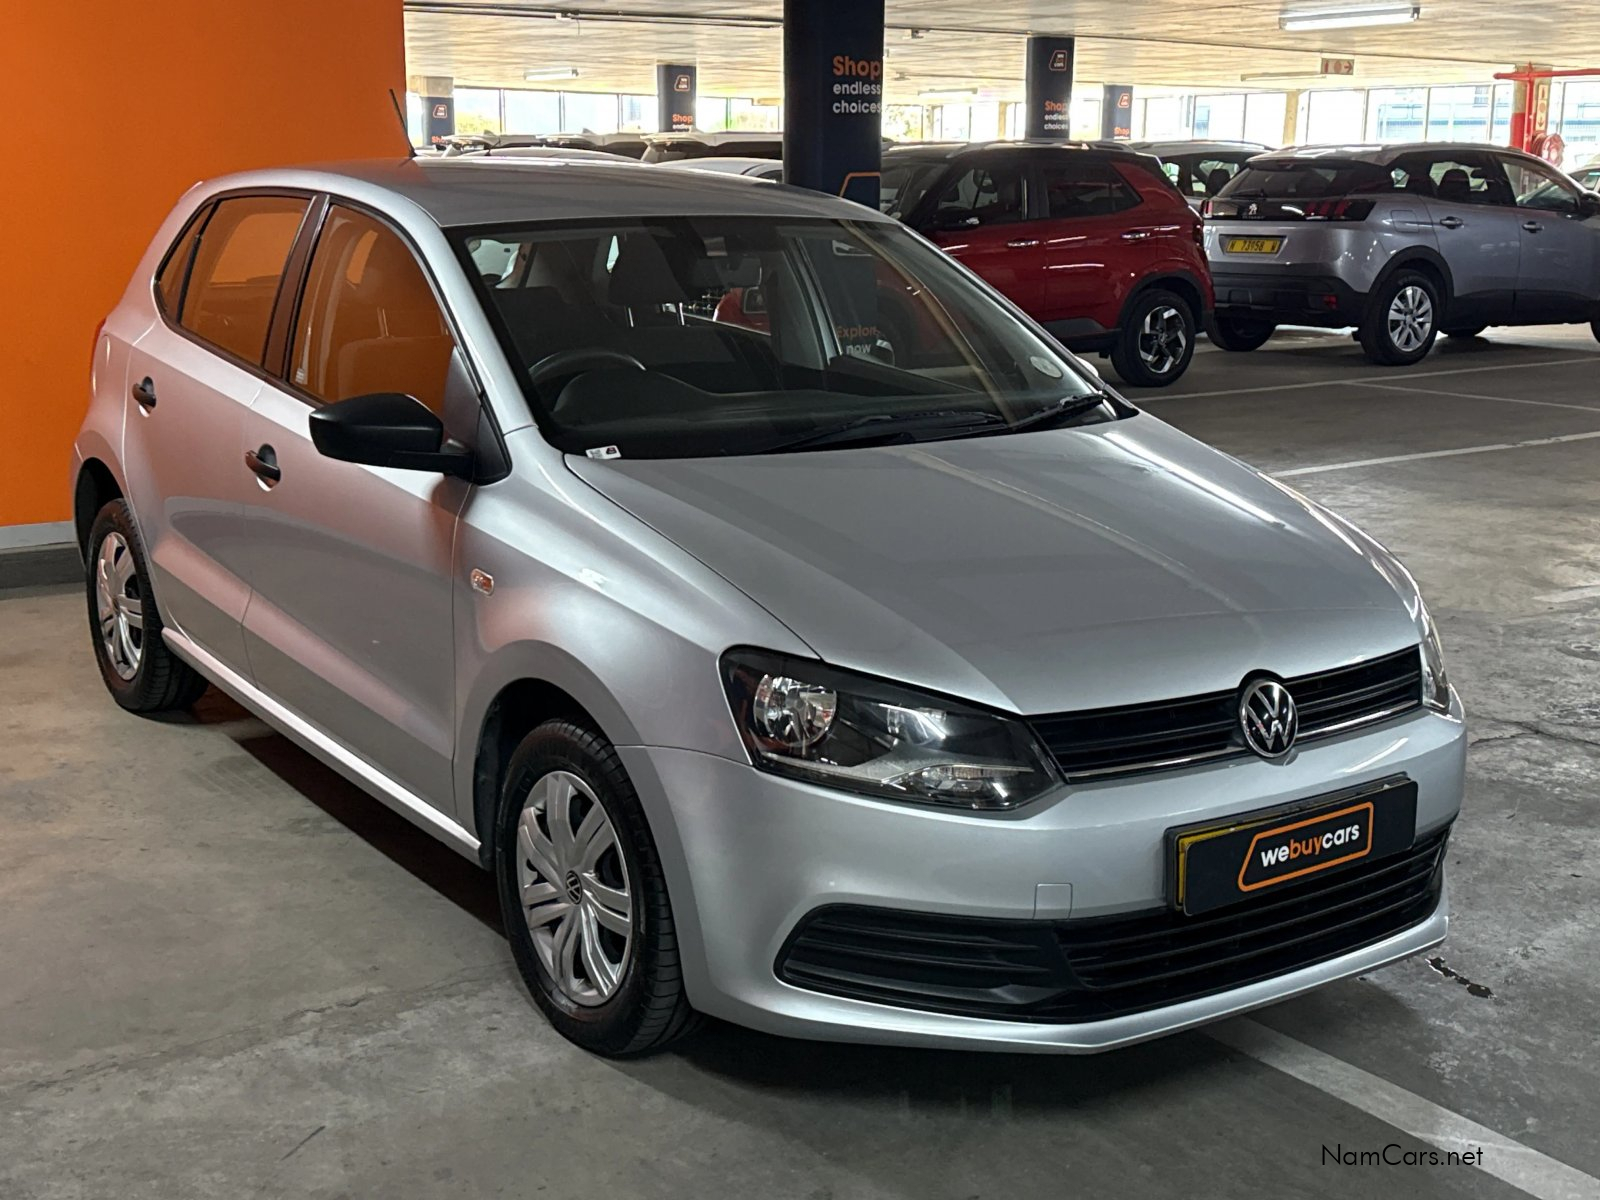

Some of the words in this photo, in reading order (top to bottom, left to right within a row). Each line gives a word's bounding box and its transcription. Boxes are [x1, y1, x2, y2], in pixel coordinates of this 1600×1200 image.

[832, 55, 881, 80] Shop
[832, 81, 881, 95] endless
[832, 99, 882, 114] choices
[1044, 100, 1068, 113] Shop
[672, 113, 693, 124] Shop
[1113, 126, 1130, 137] Shop
[845, 343, 872, 355] now
[1260, 823, 1360, 868] webuycars
